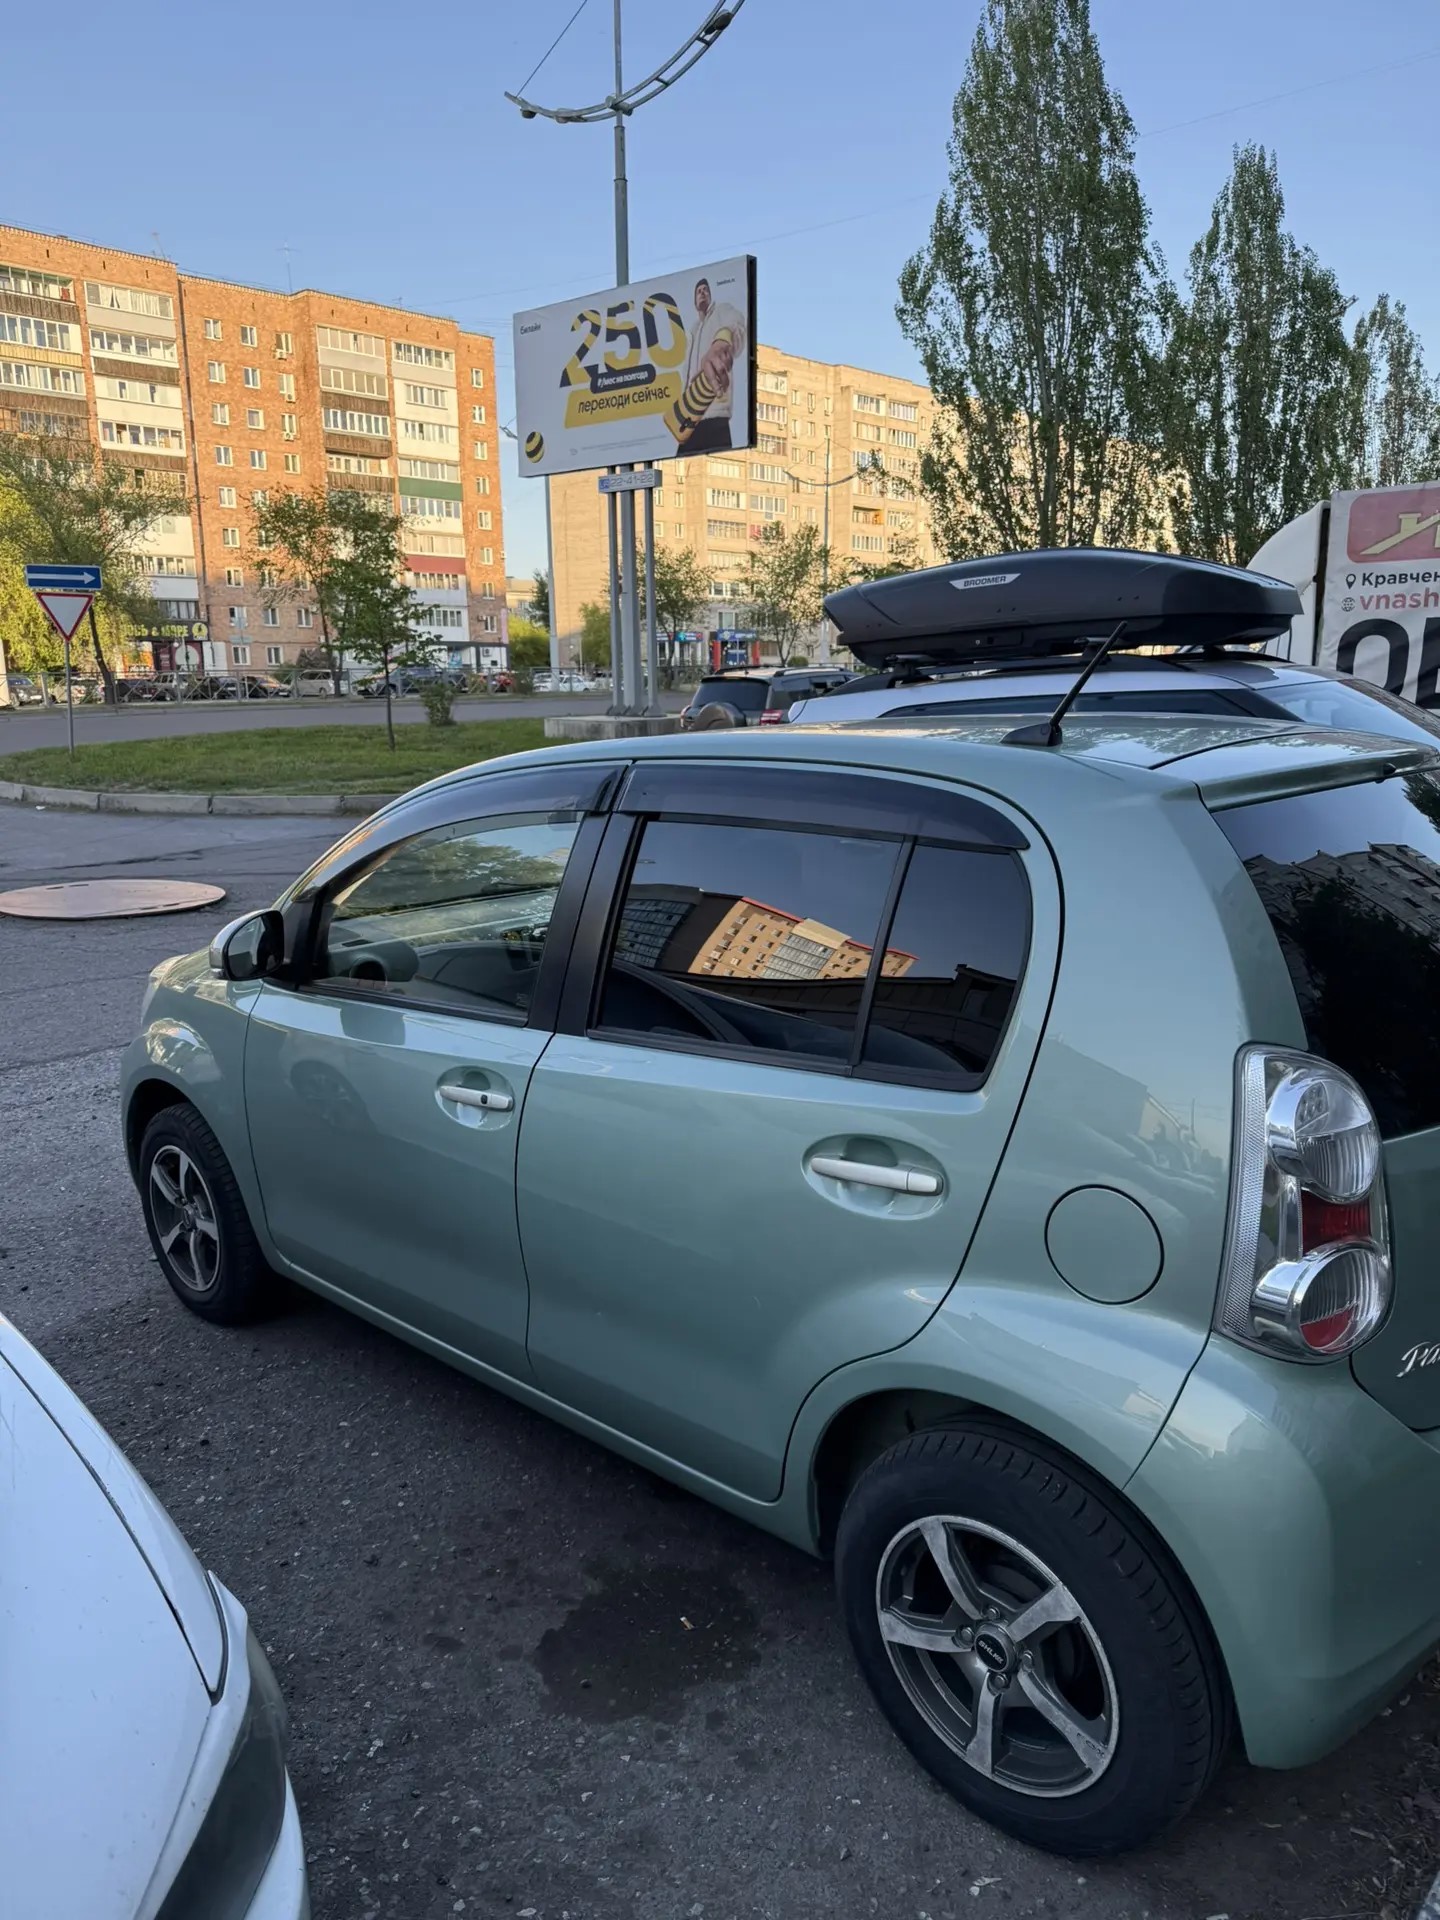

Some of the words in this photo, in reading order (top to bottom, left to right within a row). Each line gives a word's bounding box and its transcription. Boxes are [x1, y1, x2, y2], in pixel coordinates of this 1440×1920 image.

[560, 293, 687, 387] 250
[578, 392, 630, 415] переходи
[632, 386, 671, 403] сейчас
[1360, 587, 1440, 610] vnash
